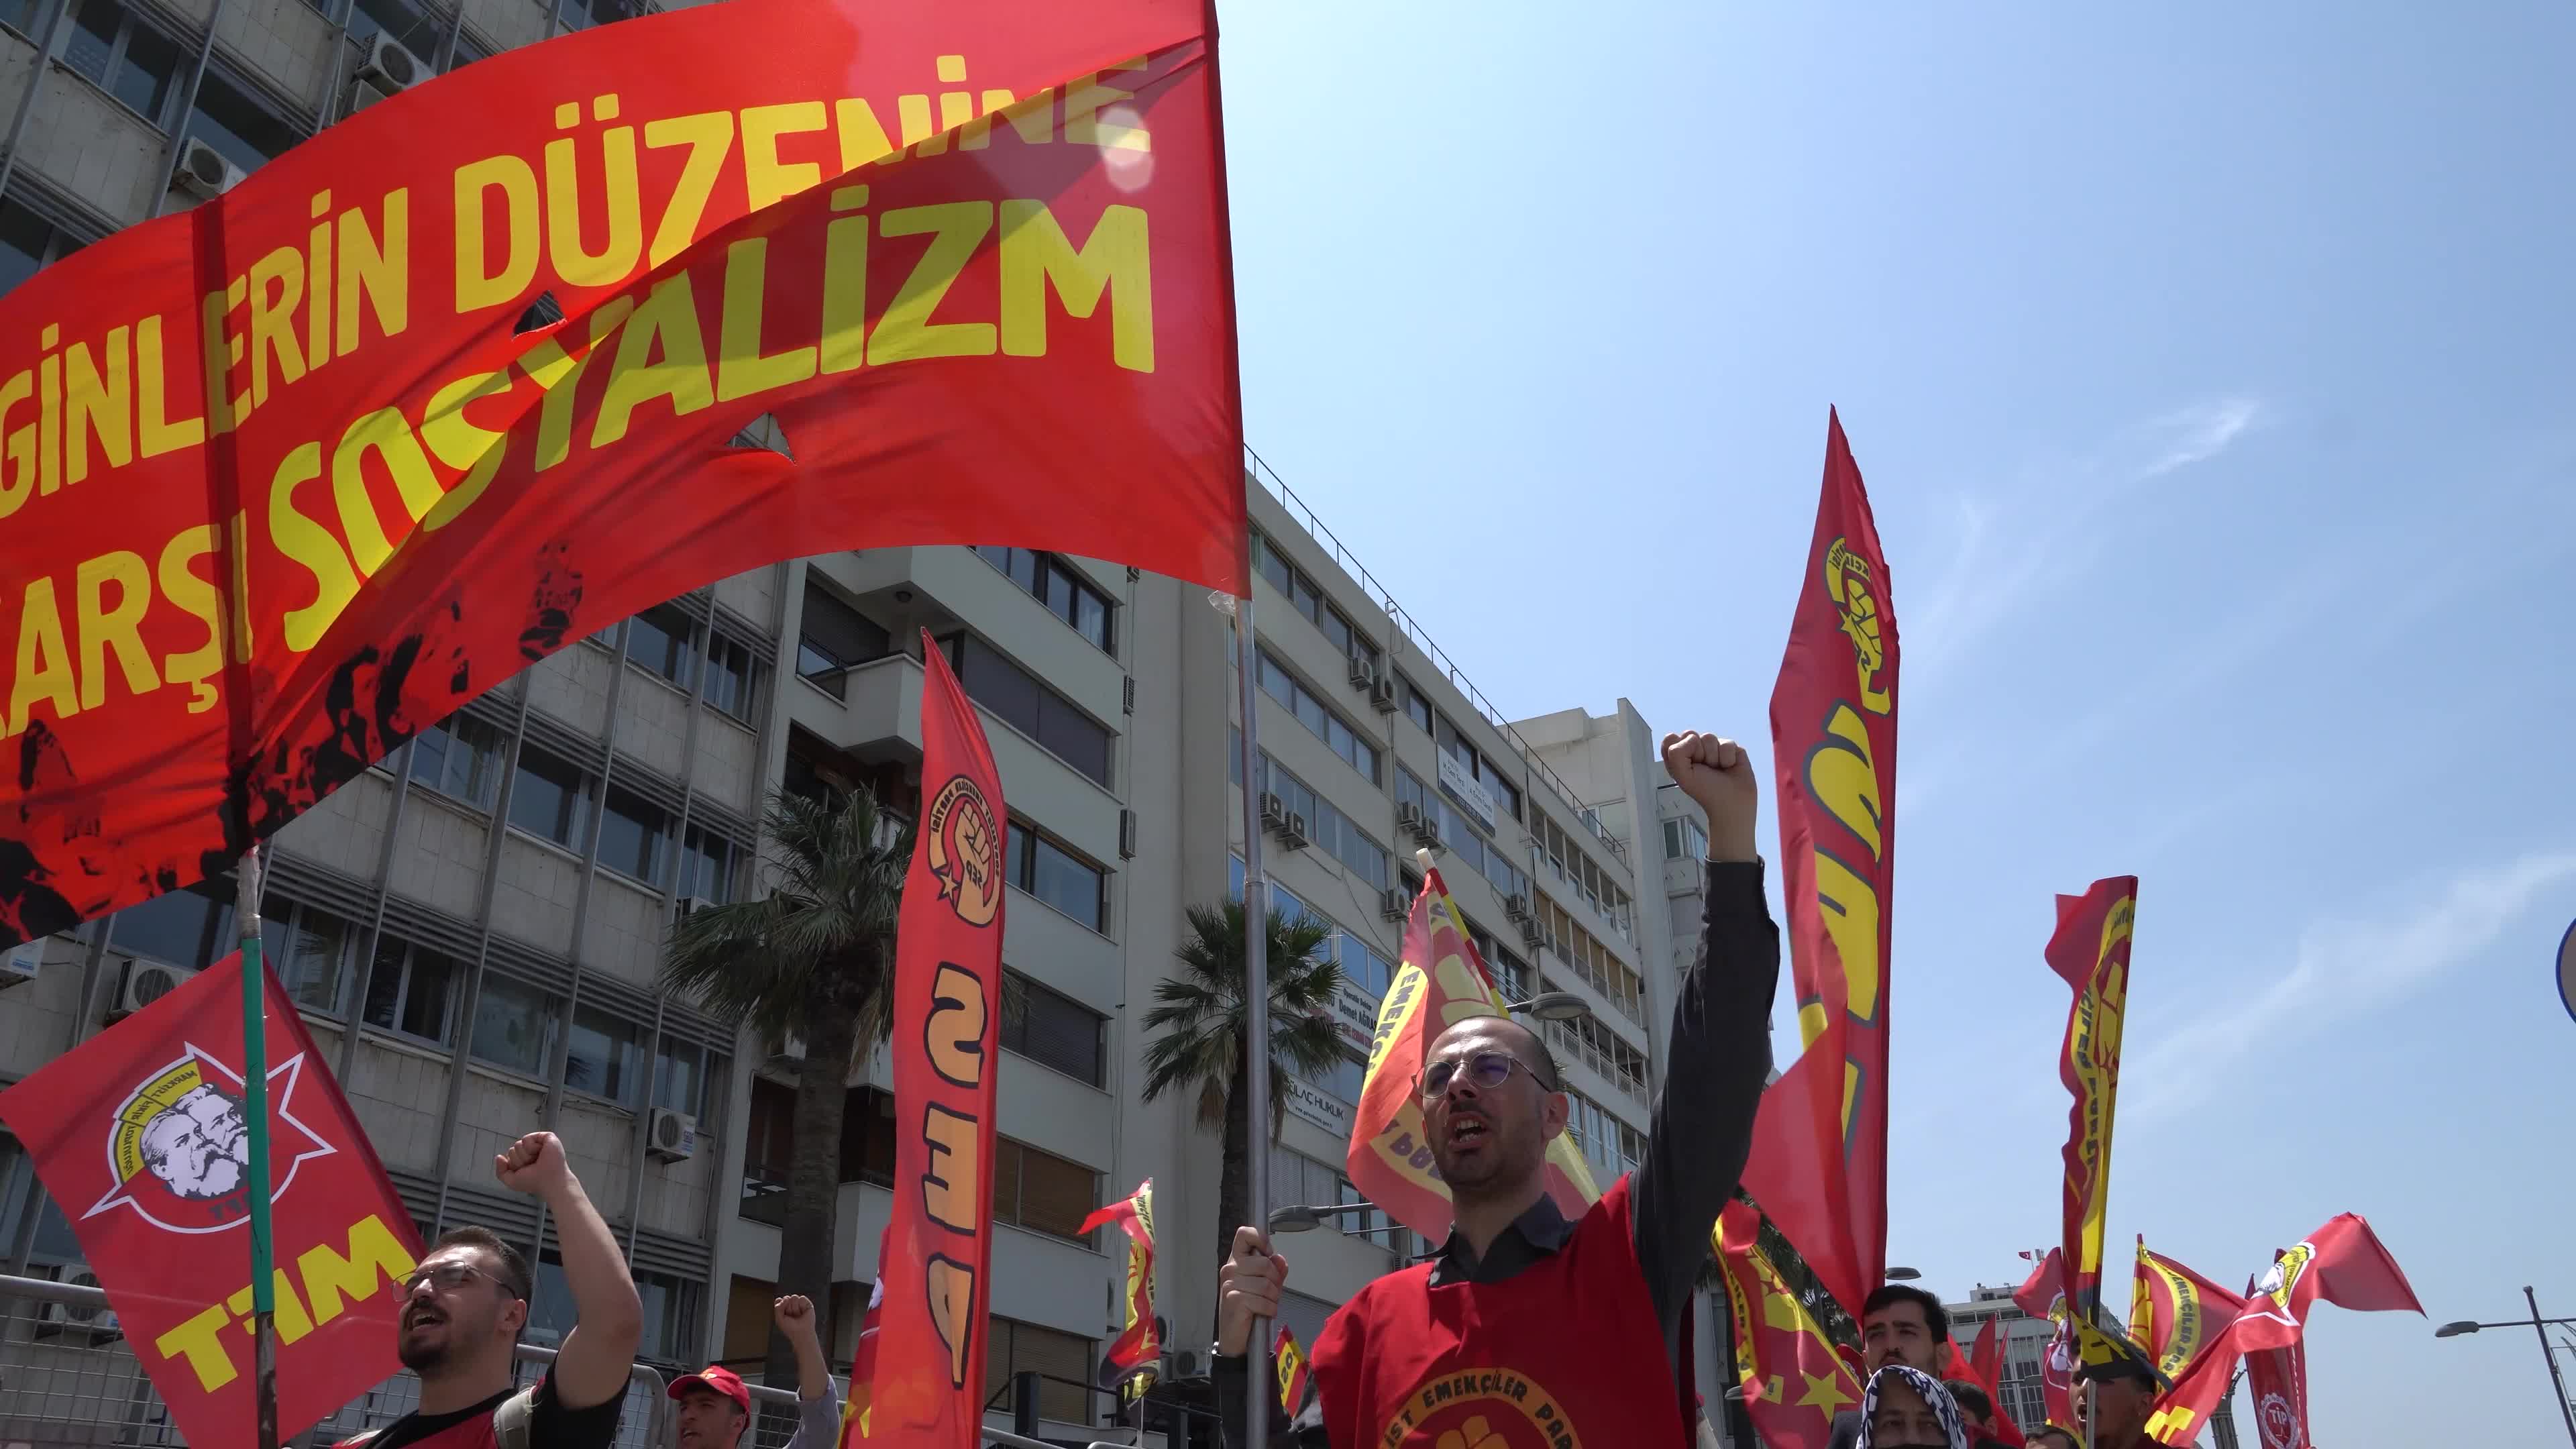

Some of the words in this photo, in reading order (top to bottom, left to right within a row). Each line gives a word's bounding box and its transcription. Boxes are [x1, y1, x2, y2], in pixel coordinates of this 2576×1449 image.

[0, 507, 254, 738] ARŞI
[269, 184, 1155, 653] SOSYALİZM
[1339, 998, 1358, 1022] Demet
[1315, 1095, 1344, 1122] HUKUK
[1421, 1370, 1527, 1409] EMEKÇİLER
[2269, 1406, 2288, 1425] TİP
